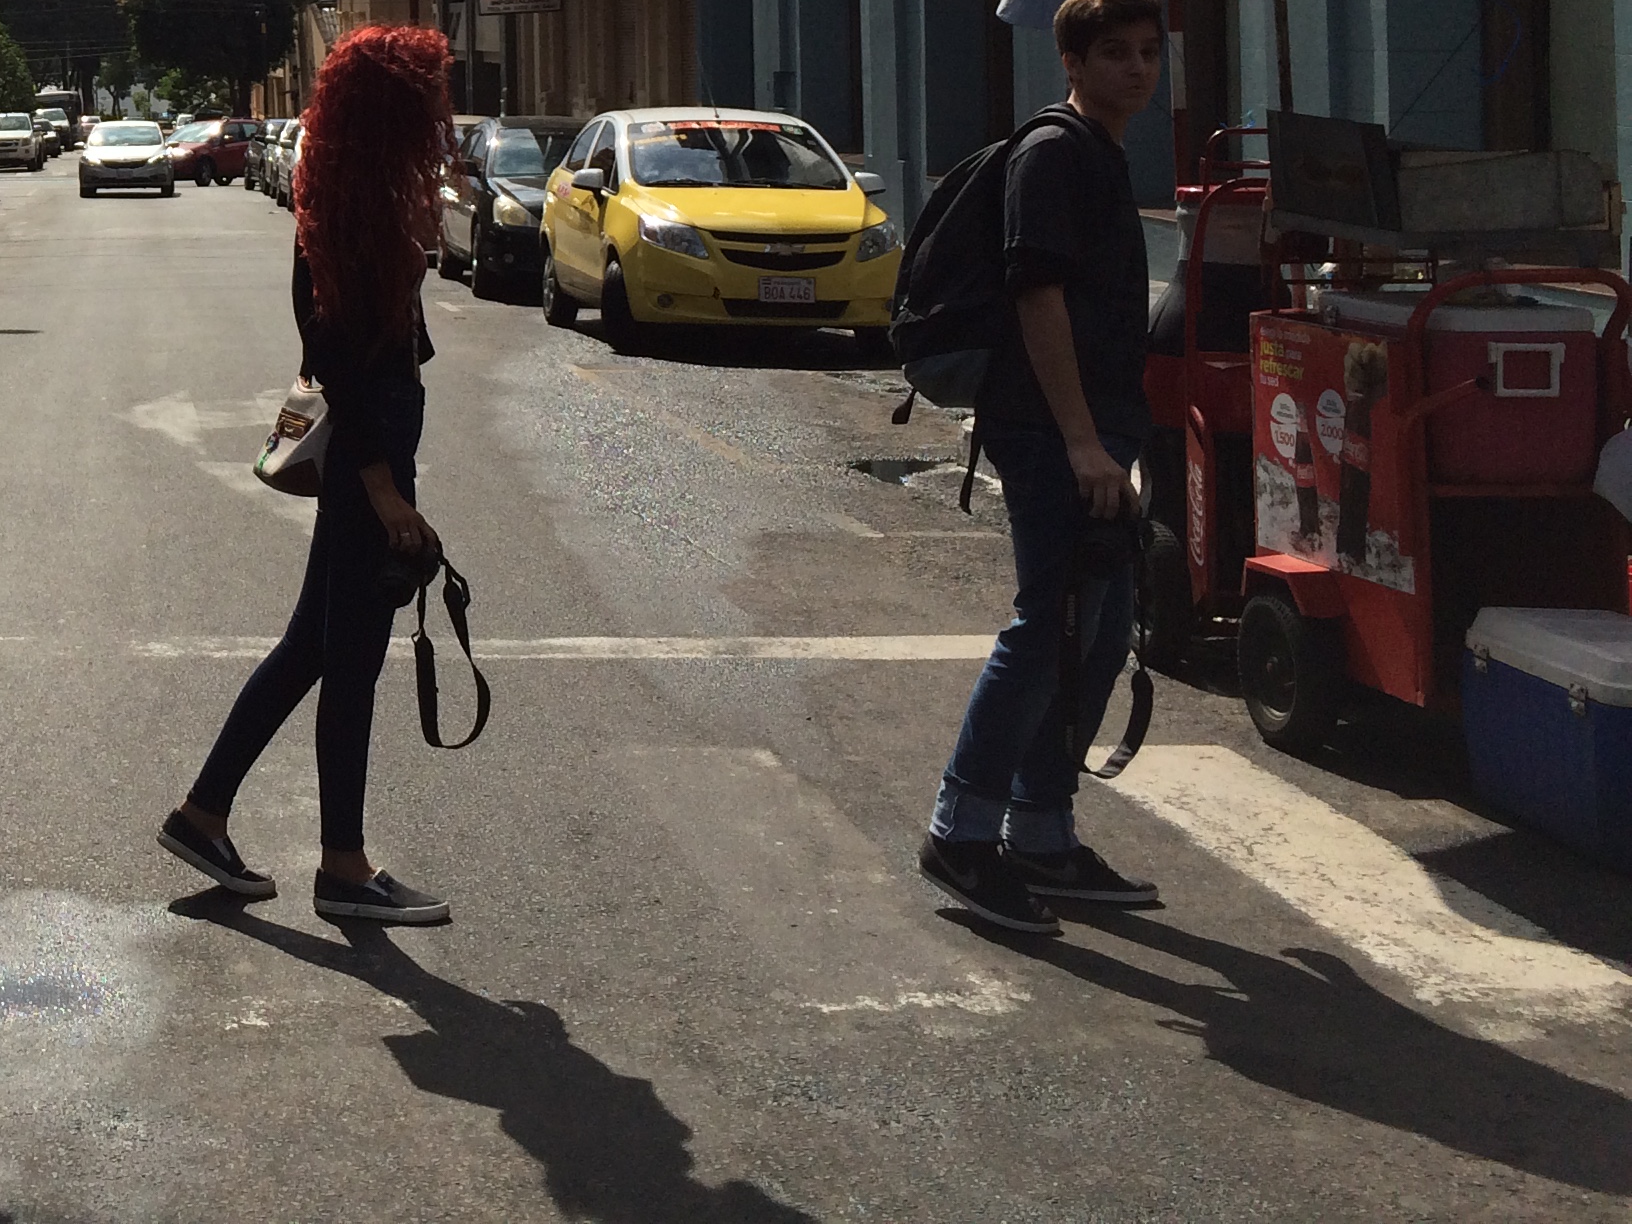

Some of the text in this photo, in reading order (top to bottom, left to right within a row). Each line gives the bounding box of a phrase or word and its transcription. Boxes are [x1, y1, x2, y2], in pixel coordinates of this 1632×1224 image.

[790, 287, 811, 300] 446
[1260, 337, 1284, 357] justa
[1260, 358, 1304, 380] refrescar
[1187, 456, 1205, 567] Coca-Cola
